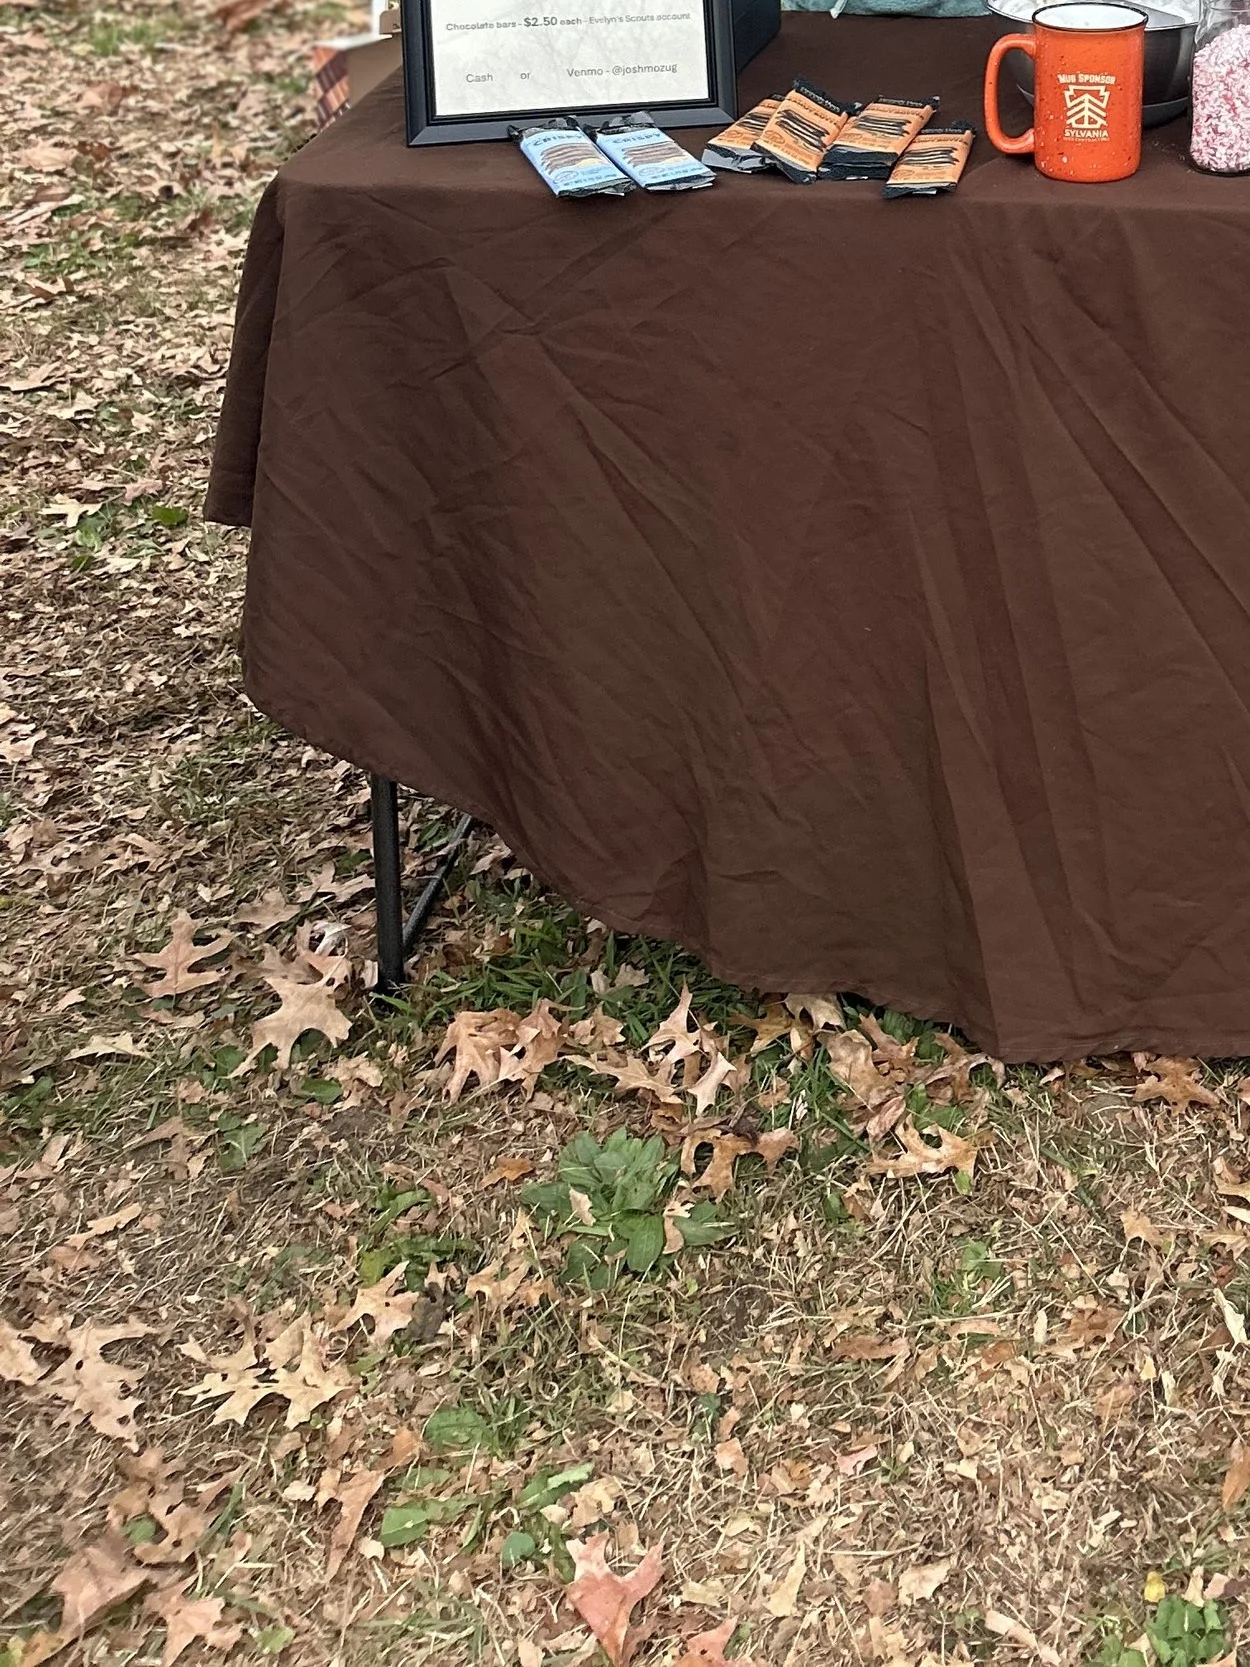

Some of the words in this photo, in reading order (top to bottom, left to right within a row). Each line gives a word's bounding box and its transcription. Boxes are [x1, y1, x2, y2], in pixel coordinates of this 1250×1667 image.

[446, 22, 495, 31] Chocolate
[496, 21, 517, 29] bars
[524, 17, 558, 28] $2.50
[560, 18, 582, 26] each
[589, 16, 624, 25] Evelyn's
[625, 15, 655, 23] Scouts
[656, 13, 691, 21] account
[466, 73, 494, 84] Cash
[520, 72, 531, 80] or
[566, 67, 604, 78] Venmo
[612, 64, 678, 76] @joshmozug
[1078, 74, 1116, 85] SPONSOR
[1064, 129, 1109, 138] SYLVANIA
